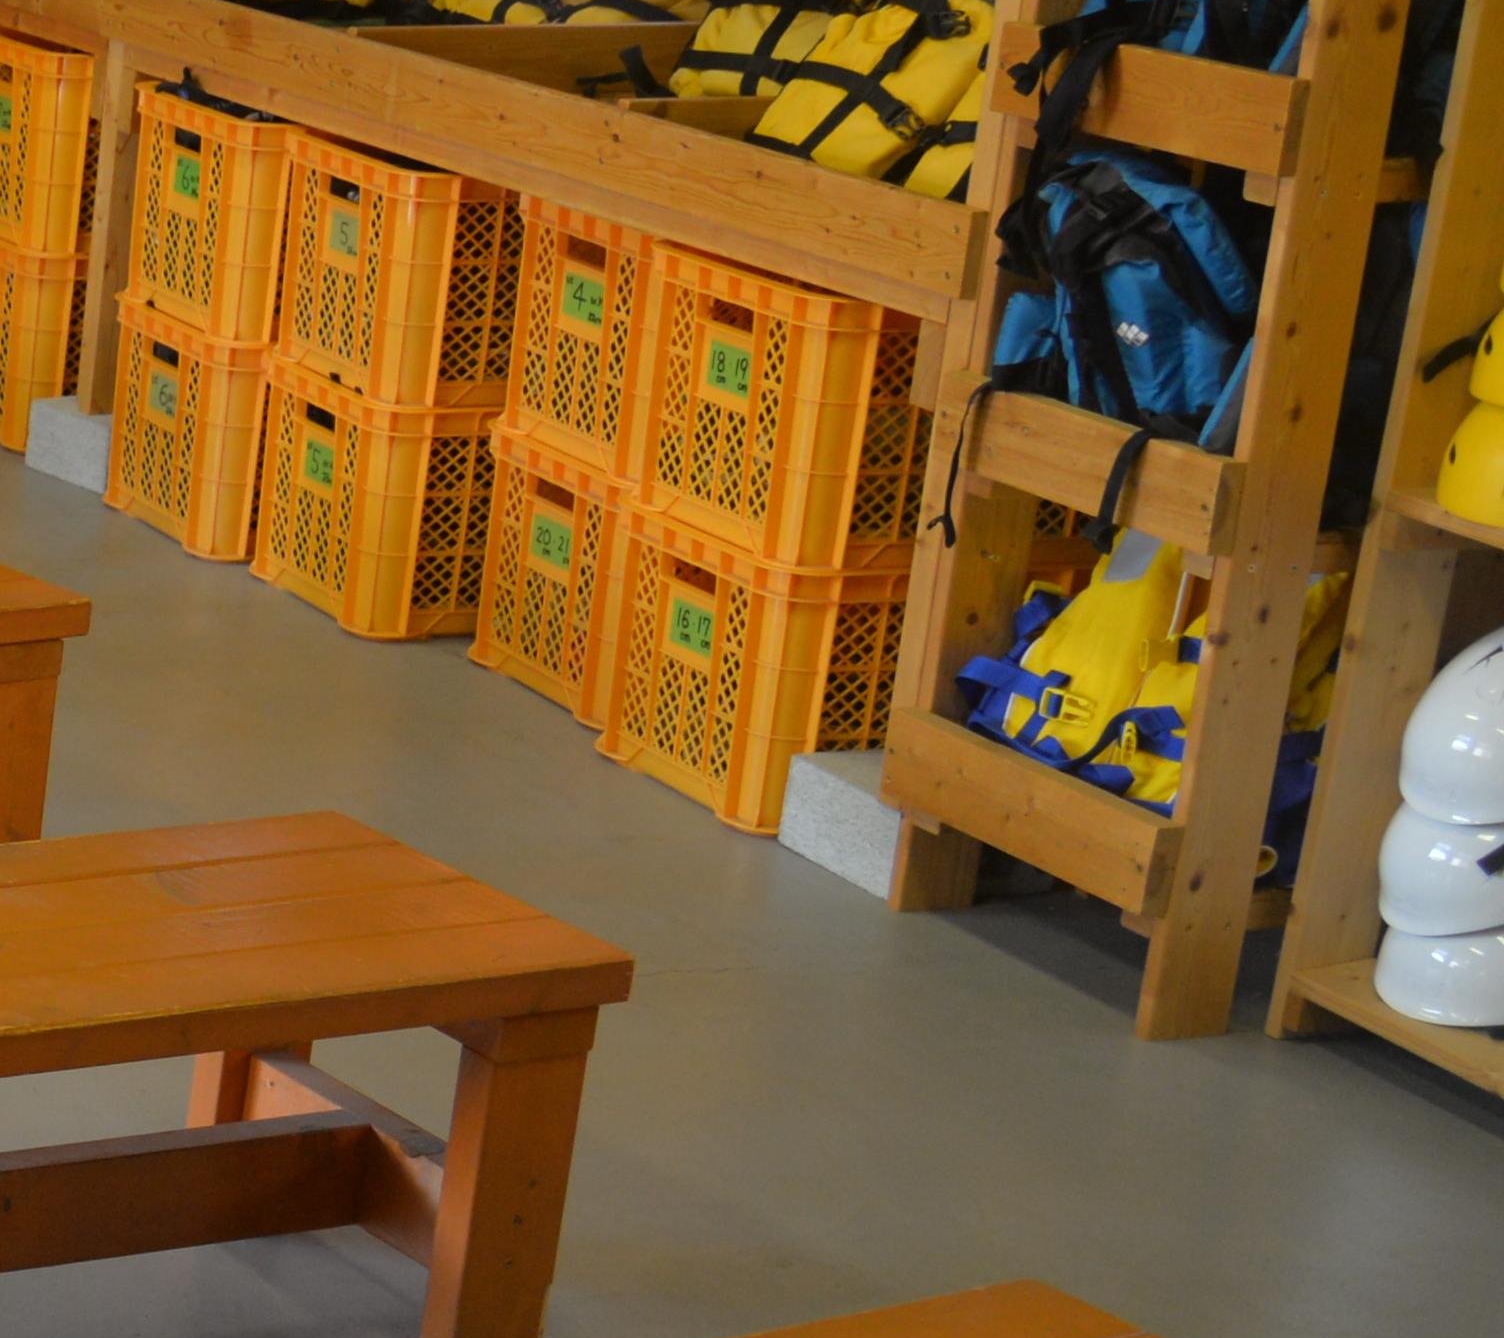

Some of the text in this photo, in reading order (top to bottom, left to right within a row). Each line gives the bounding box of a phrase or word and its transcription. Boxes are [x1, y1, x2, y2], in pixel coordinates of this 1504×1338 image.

[181, 165, 190, 190] 6
[340, 221, 349, 245] 5
[573, 282, 586, 311] 4
[158, 383, 168, 406] 6
[312, 448, 321, 474] 5
